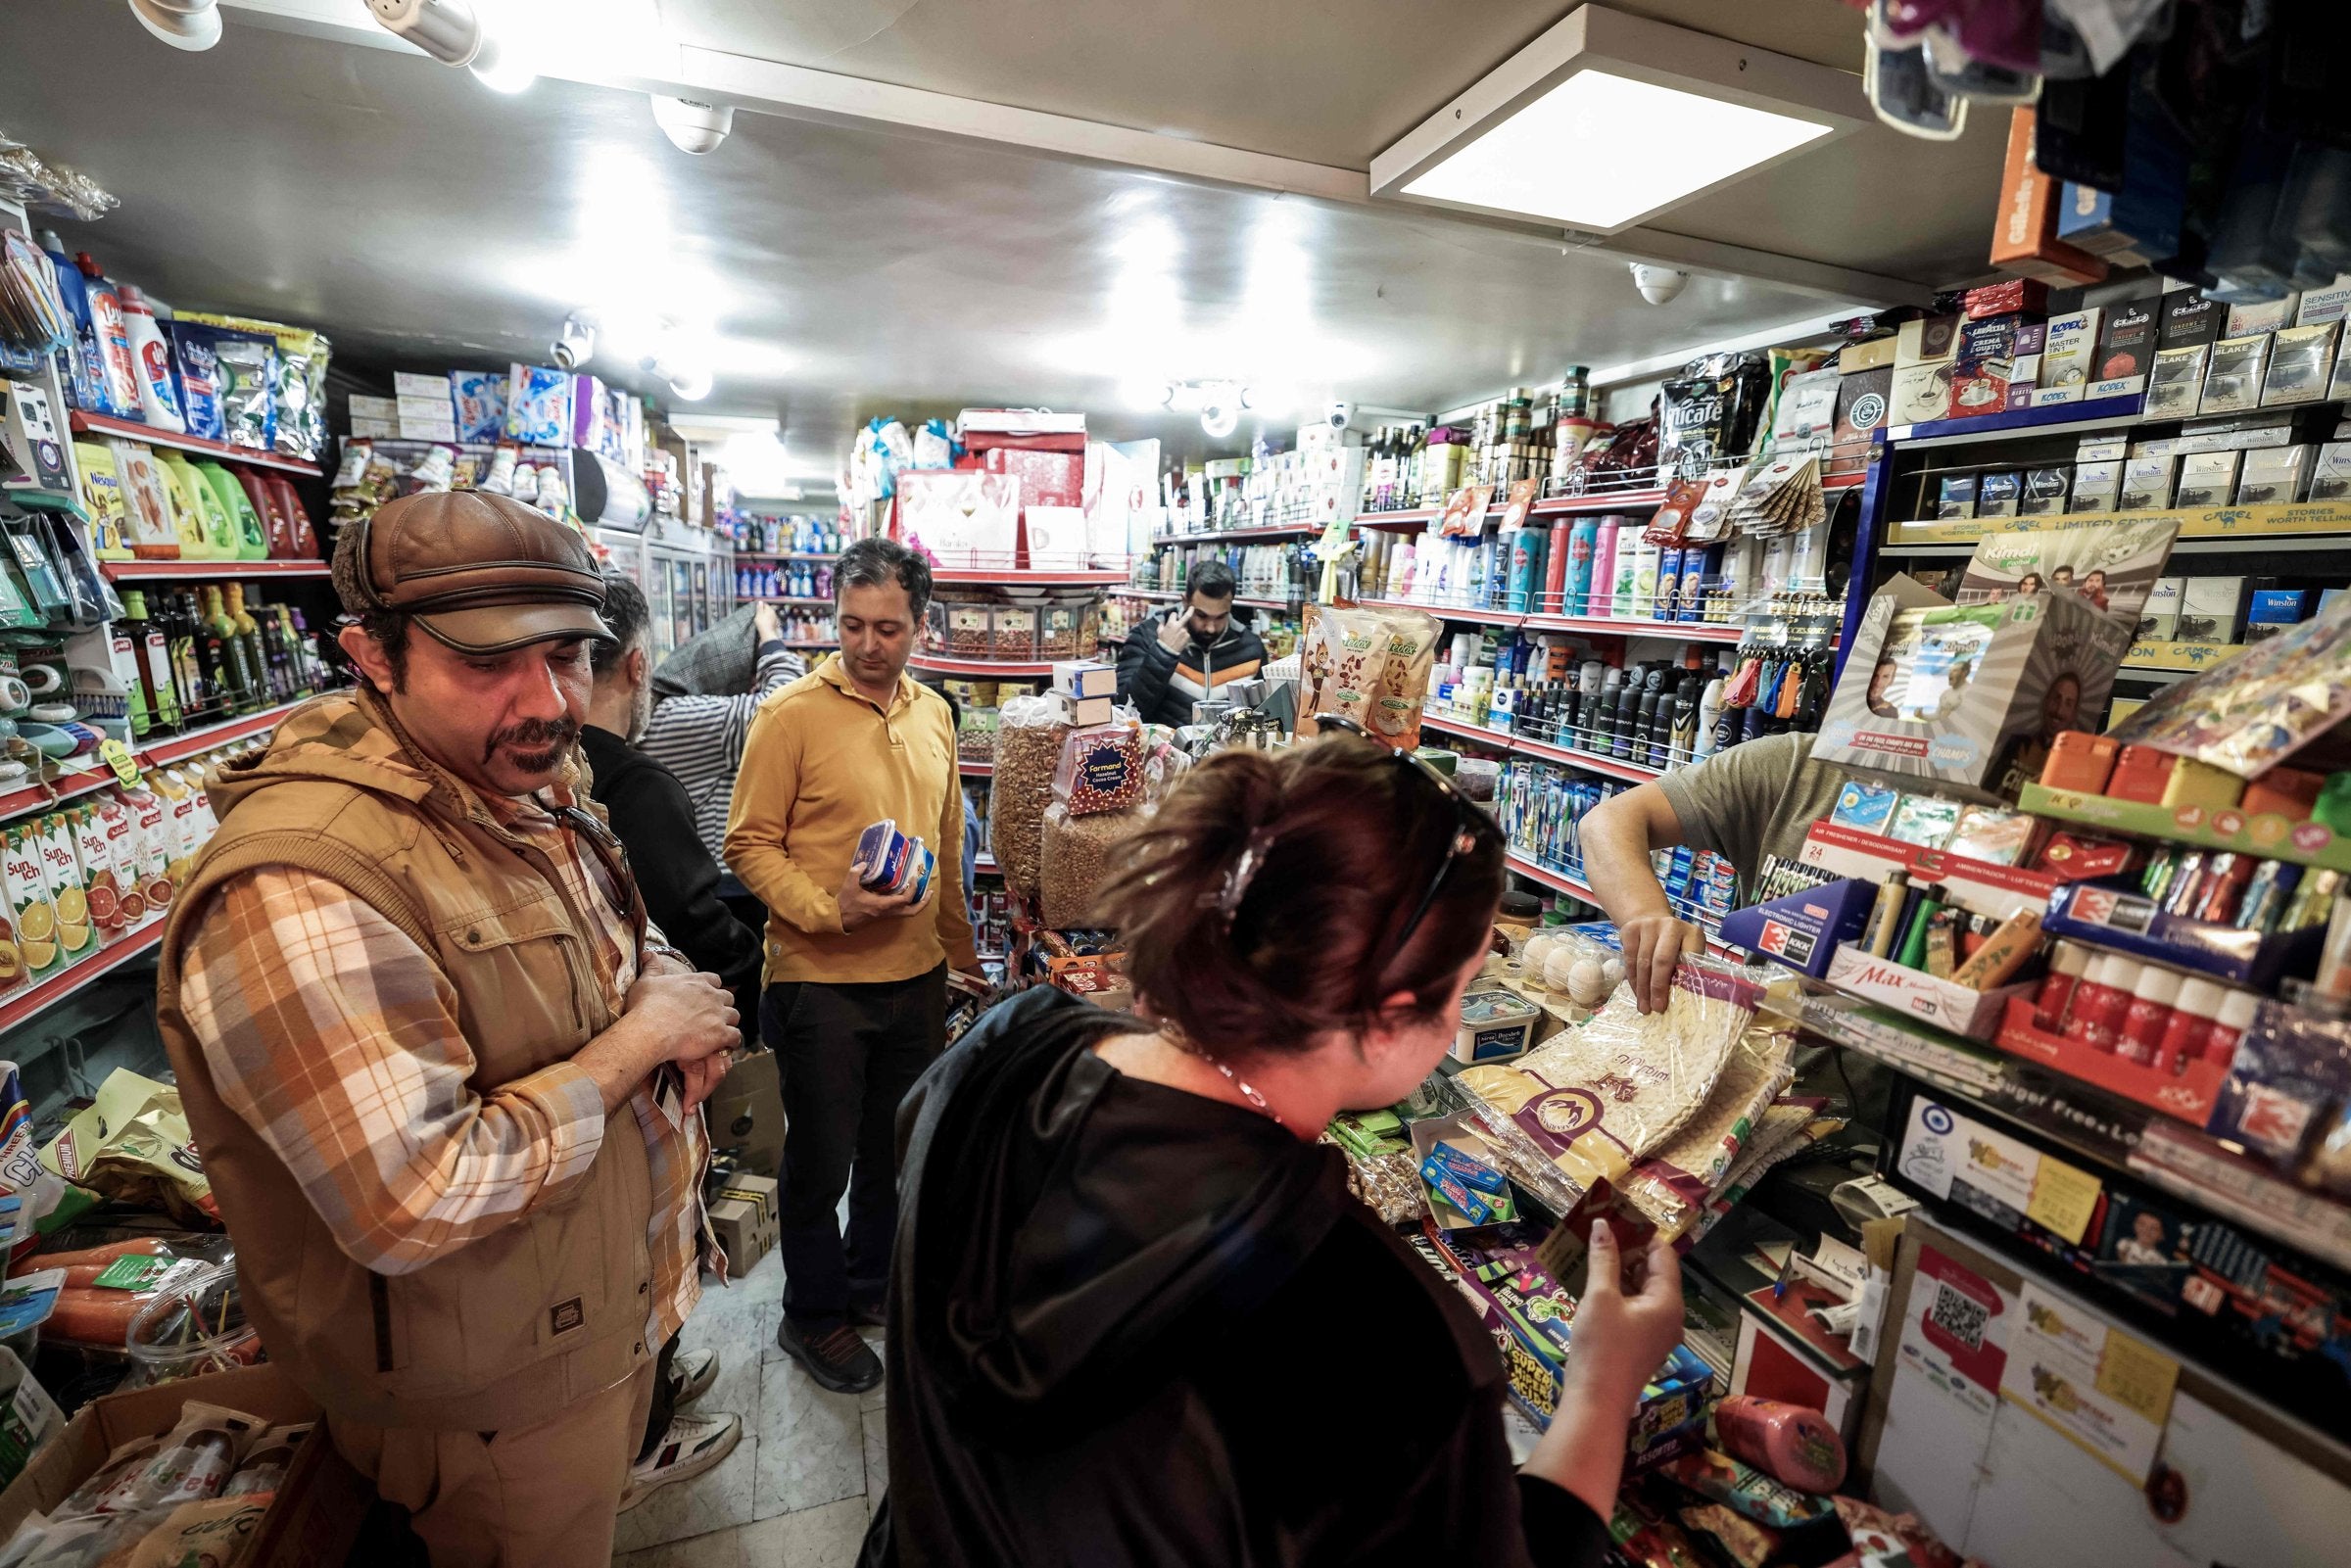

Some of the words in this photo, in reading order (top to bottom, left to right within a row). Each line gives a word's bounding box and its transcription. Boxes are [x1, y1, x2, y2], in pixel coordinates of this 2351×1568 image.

[2303, 297, 2351, 311] Pro-Sensatio
[2304, 290, 2351, 306] SENSITIV
[2050, 318, 2082, 334] KODEX
[2229, 329, 2248, 338] FOR
[2248, 322, 2282, 336] G-SPOT
[1973, 338, 2001, 347] CREMA
[1975, 343, 2003, 354] GUSTO
[2047, 338, 2081, 349] MASTER
[2214, 344, 2248, 356] BLAKE
[2156, 355, 2189, 365] BLAKE
[2096, 381, 2127, 393] KODEX
[2040, 391, 2068, 403] KODEX
[2332, 455, 2351, 465] Wins
[2135, 468, 2161, 477] Winston
[2195, 464, 2224, 473] Winston
[90, 471, 117, 489] Nesqui
[2085, 473, 2110, 482] Winston
[1991, 483, 2013, 492] Winston
[2035, 480, 2059, 490] Winston
[2202, 509, 2253, 524] CAMEL
[2286, 508, 2335, 517] STORIES
[2004, 519, 2040, 531] CAMEL
[2054, 518, 2114, 531] LIMITED
[2266, 515, 2312, 525] WORTH
[2267, 597, 2297, 608] Winston
[1941, 639, 1981, 653] Kimdi
[2172, 646, 2221, 662] CAMEL
[1089, 761, 1122, 773] Farmand
[81, 835, 99, 849] Sun
[1825, 829, 1858, 843] FRESHENER
[43, 846, 64, 862] Sun
[1809, 845, 1823, 857] 24
[7, 860, 30, 876] Sun
[1955, 862, 2006, 880] AMBIENTADOR
[1757, 907, 1795, 927] ELECTRONIC
[1794, 919, 1821, 935] LIGHTER
[1788, 937, 1811, 952] KKK
[1854, 965, 1907, 988] Max
[1911, 997, 1938, 1016] MAX
[2002, 1080, 2048, 1106] uger
[2111, 1124, 2139, 1146] Lo
[1511, 1350, 1552, 1387] SUPER
